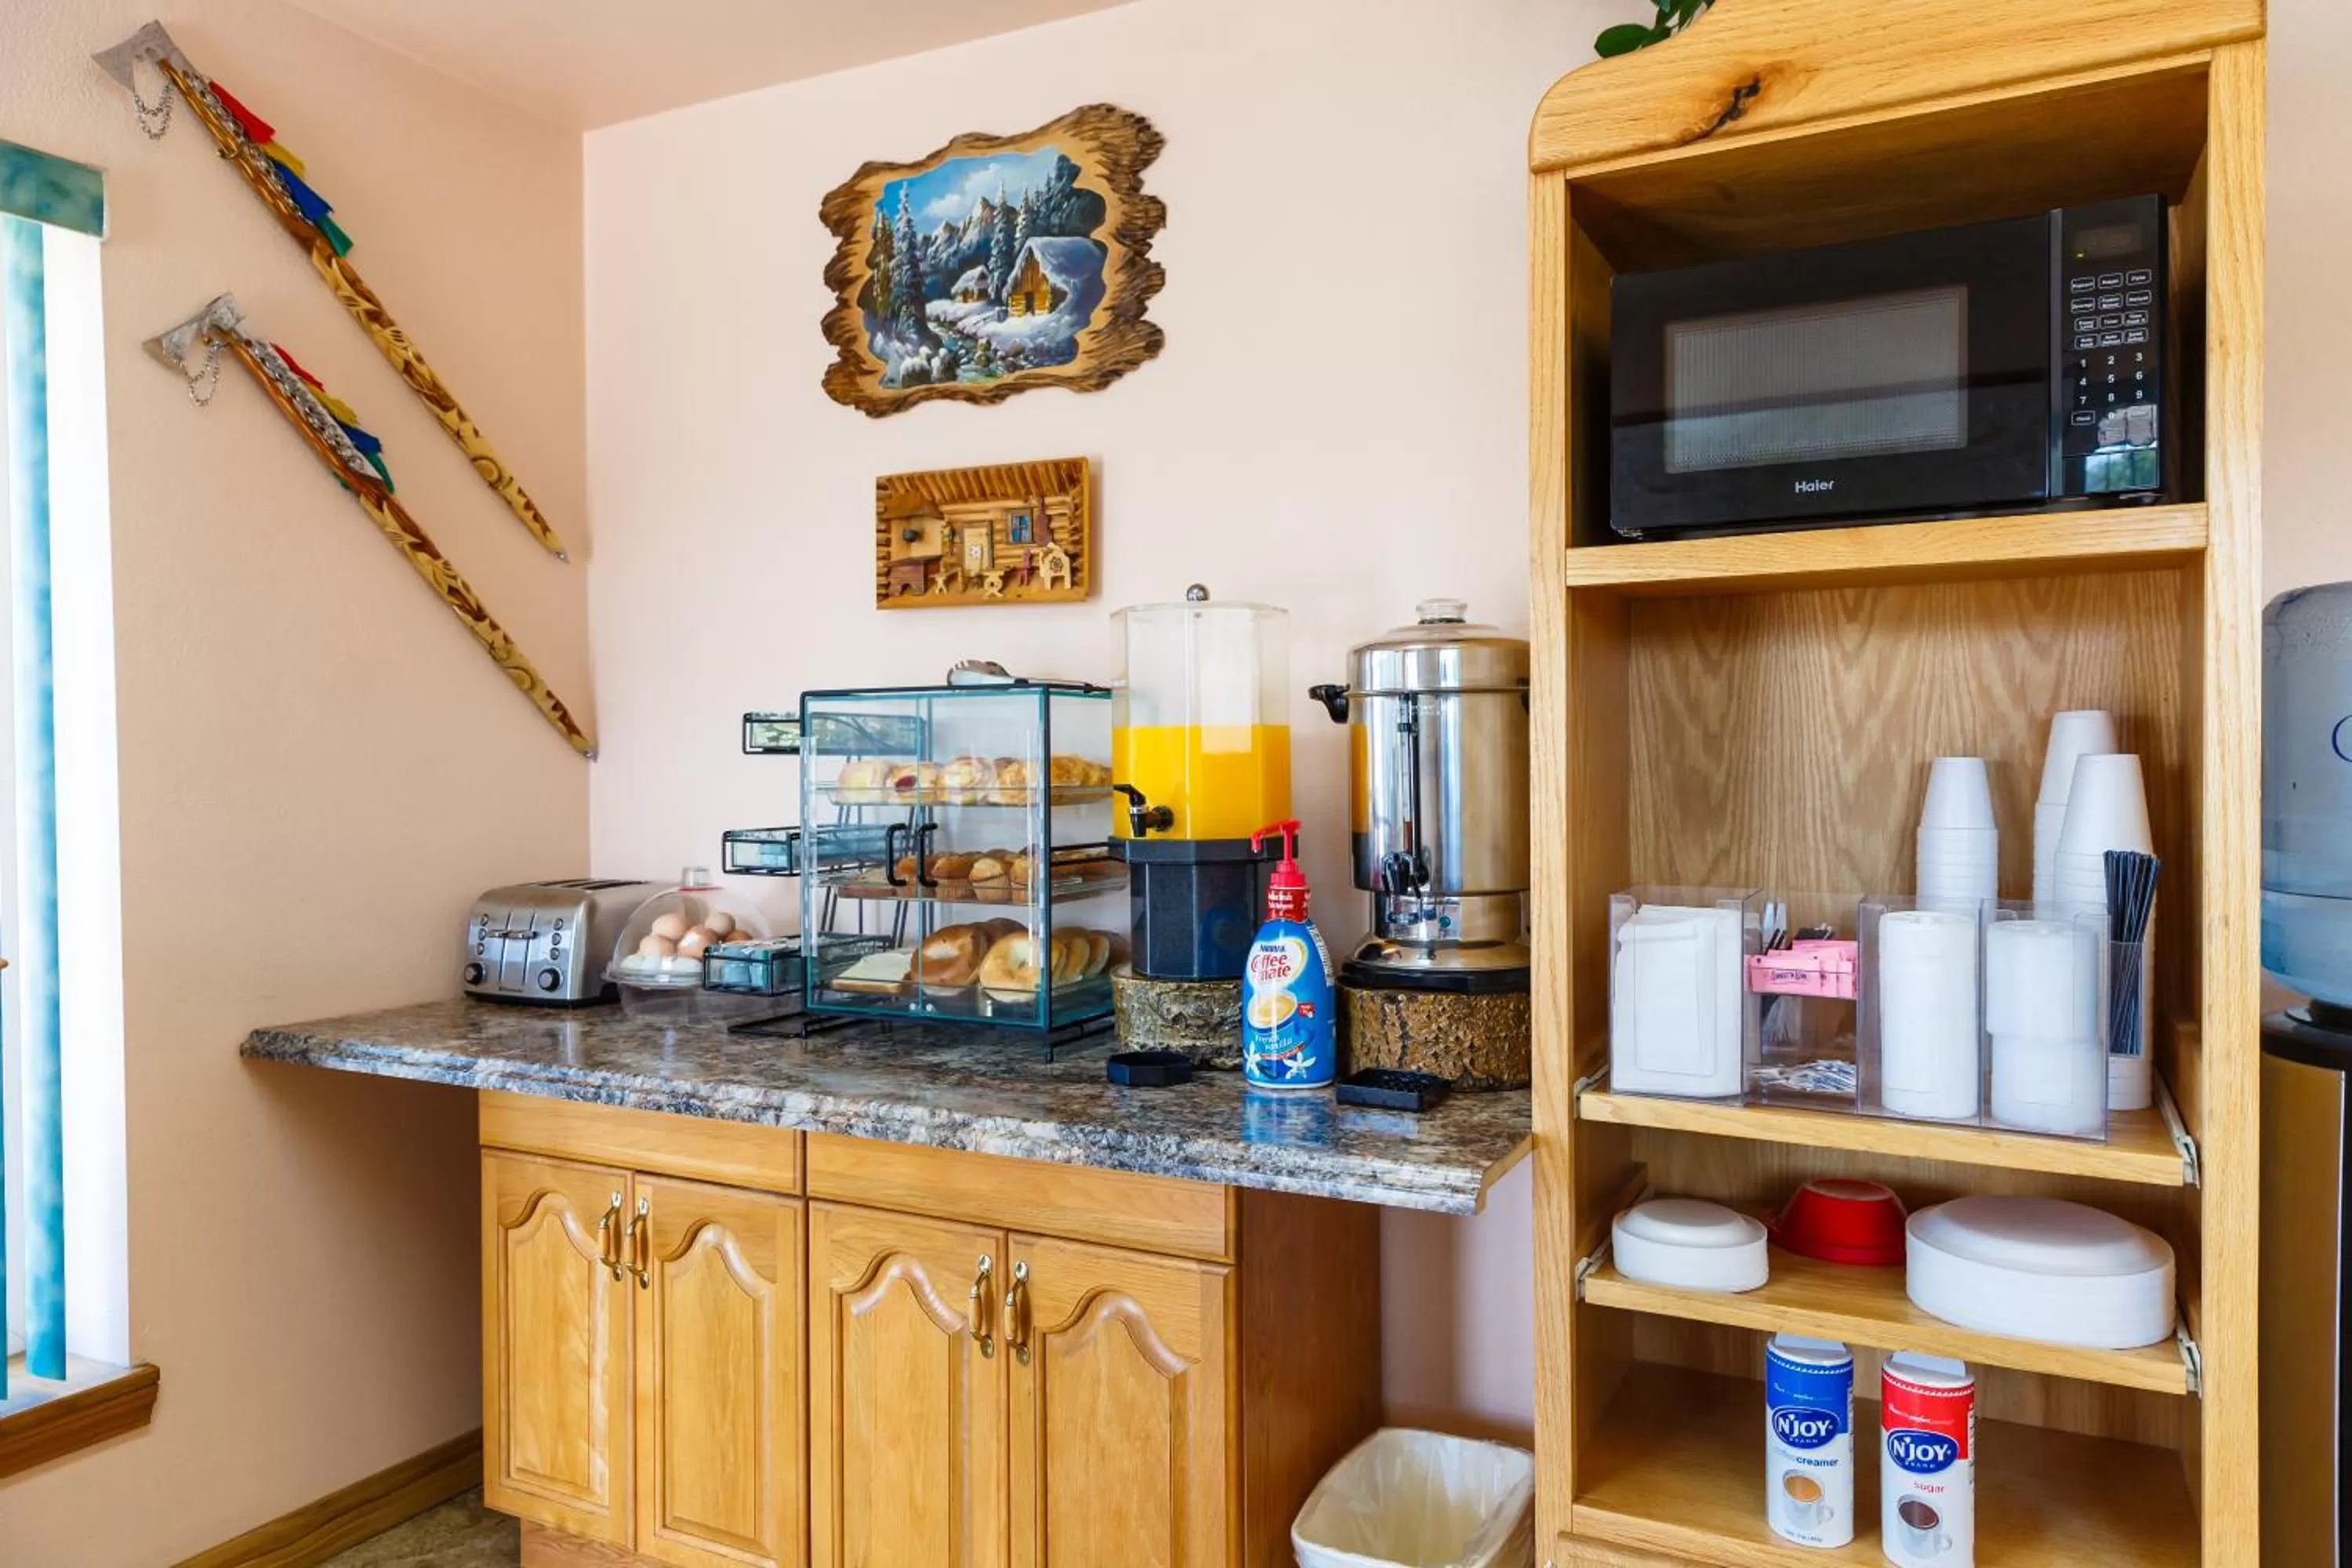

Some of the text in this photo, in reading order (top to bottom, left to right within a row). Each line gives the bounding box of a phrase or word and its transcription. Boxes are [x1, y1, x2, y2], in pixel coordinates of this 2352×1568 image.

[2081, 352, 2143, 368] 1 2 3
[2079, 371, 2143, 386] 4 5 6
[2079, 396, 2087, 405] 7
[2136, 390, 2143, 399] 9
[1795, 479, 1835, 493] Haier
[1796, 1456, 1838, 1467] creamer
